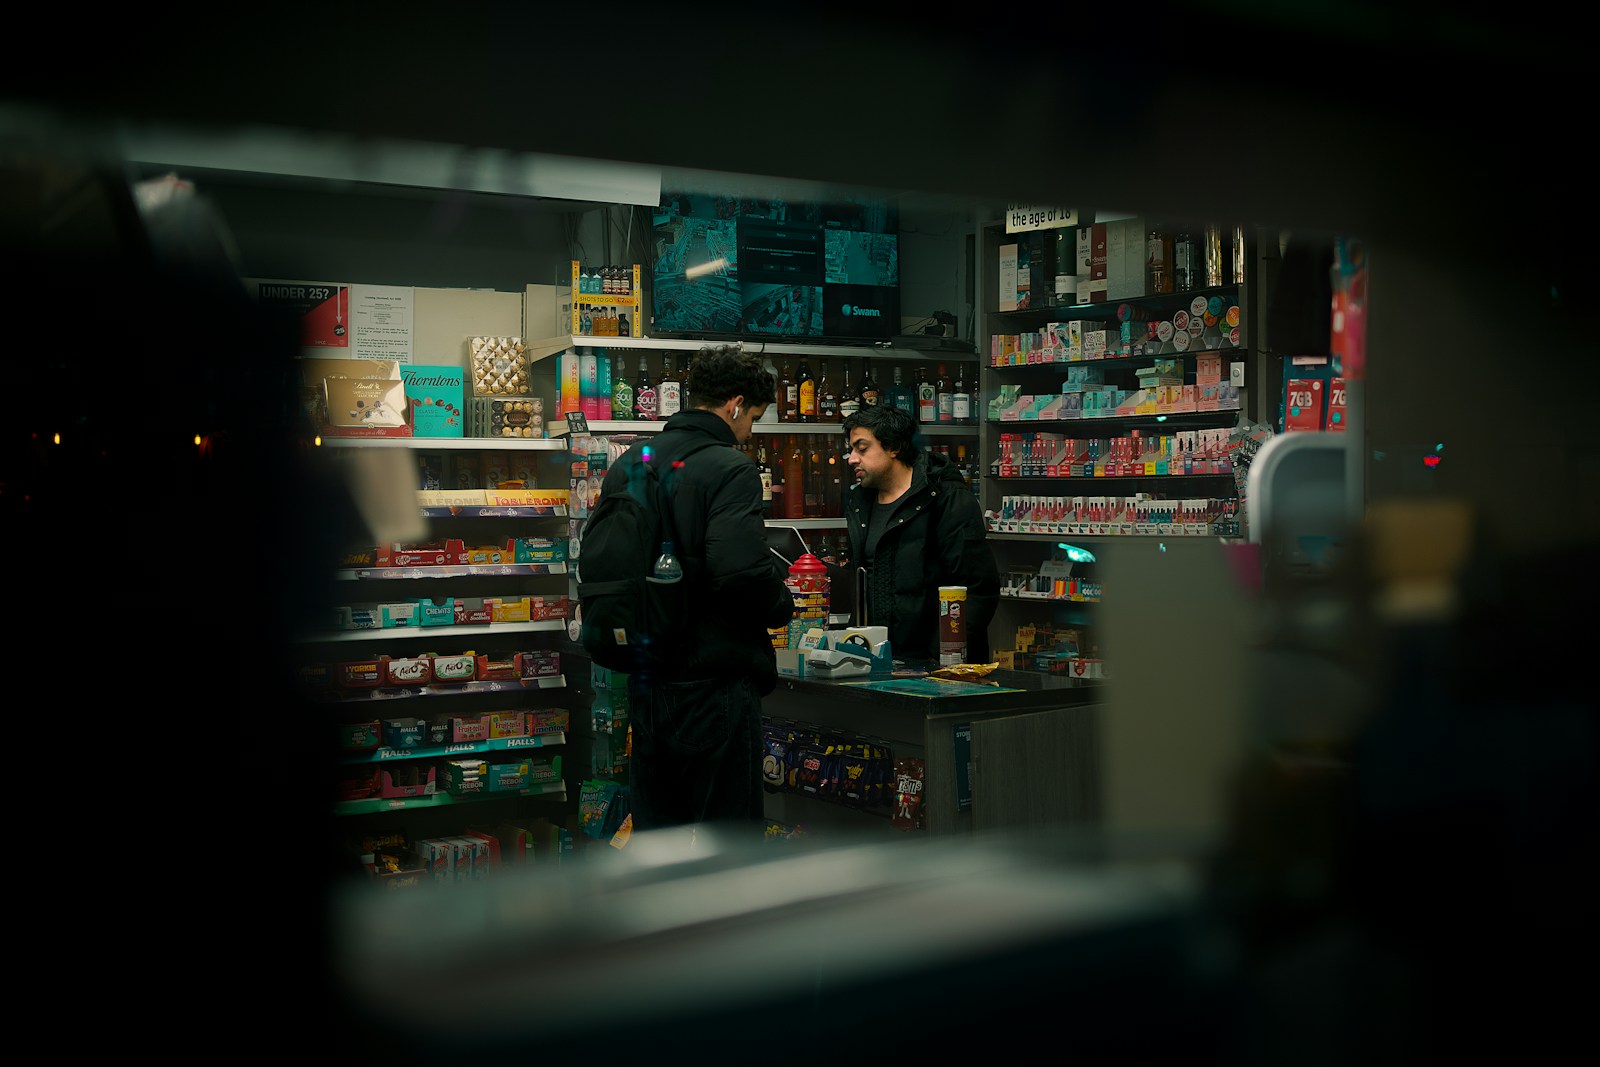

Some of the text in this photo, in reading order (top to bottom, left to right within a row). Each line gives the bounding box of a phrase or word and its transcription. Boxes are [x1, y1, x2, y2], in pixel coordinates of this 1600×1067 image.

[1012, 212, 1027, 227] the
[1029, 211, 1045, 227] age
[1048, 208, 1056, 222] of
[262, 286, 330, 300] UNDER 25?
[853, 305, 880, 317] Swann
[401, 370, 460, 387] Thorntons
[1289, 391, 1313, 407] 7GB
[1331, 389, 1346, 405] 7G
[494, 497, 567, 506] TOBLERONE
[479, 508, 501, 517] Cadbury
[426, 607, 451, 615] CHEWITS
[349, 664, 377, 673] YORKIE
[534, 725, 566, 733] mentos
[507, 738, 535, 747] HALLS
[445, 743, 475, 753] HALLS
[381, 748, 412, 759] HALLS
[458, 781, 484, 789] TREBOR
